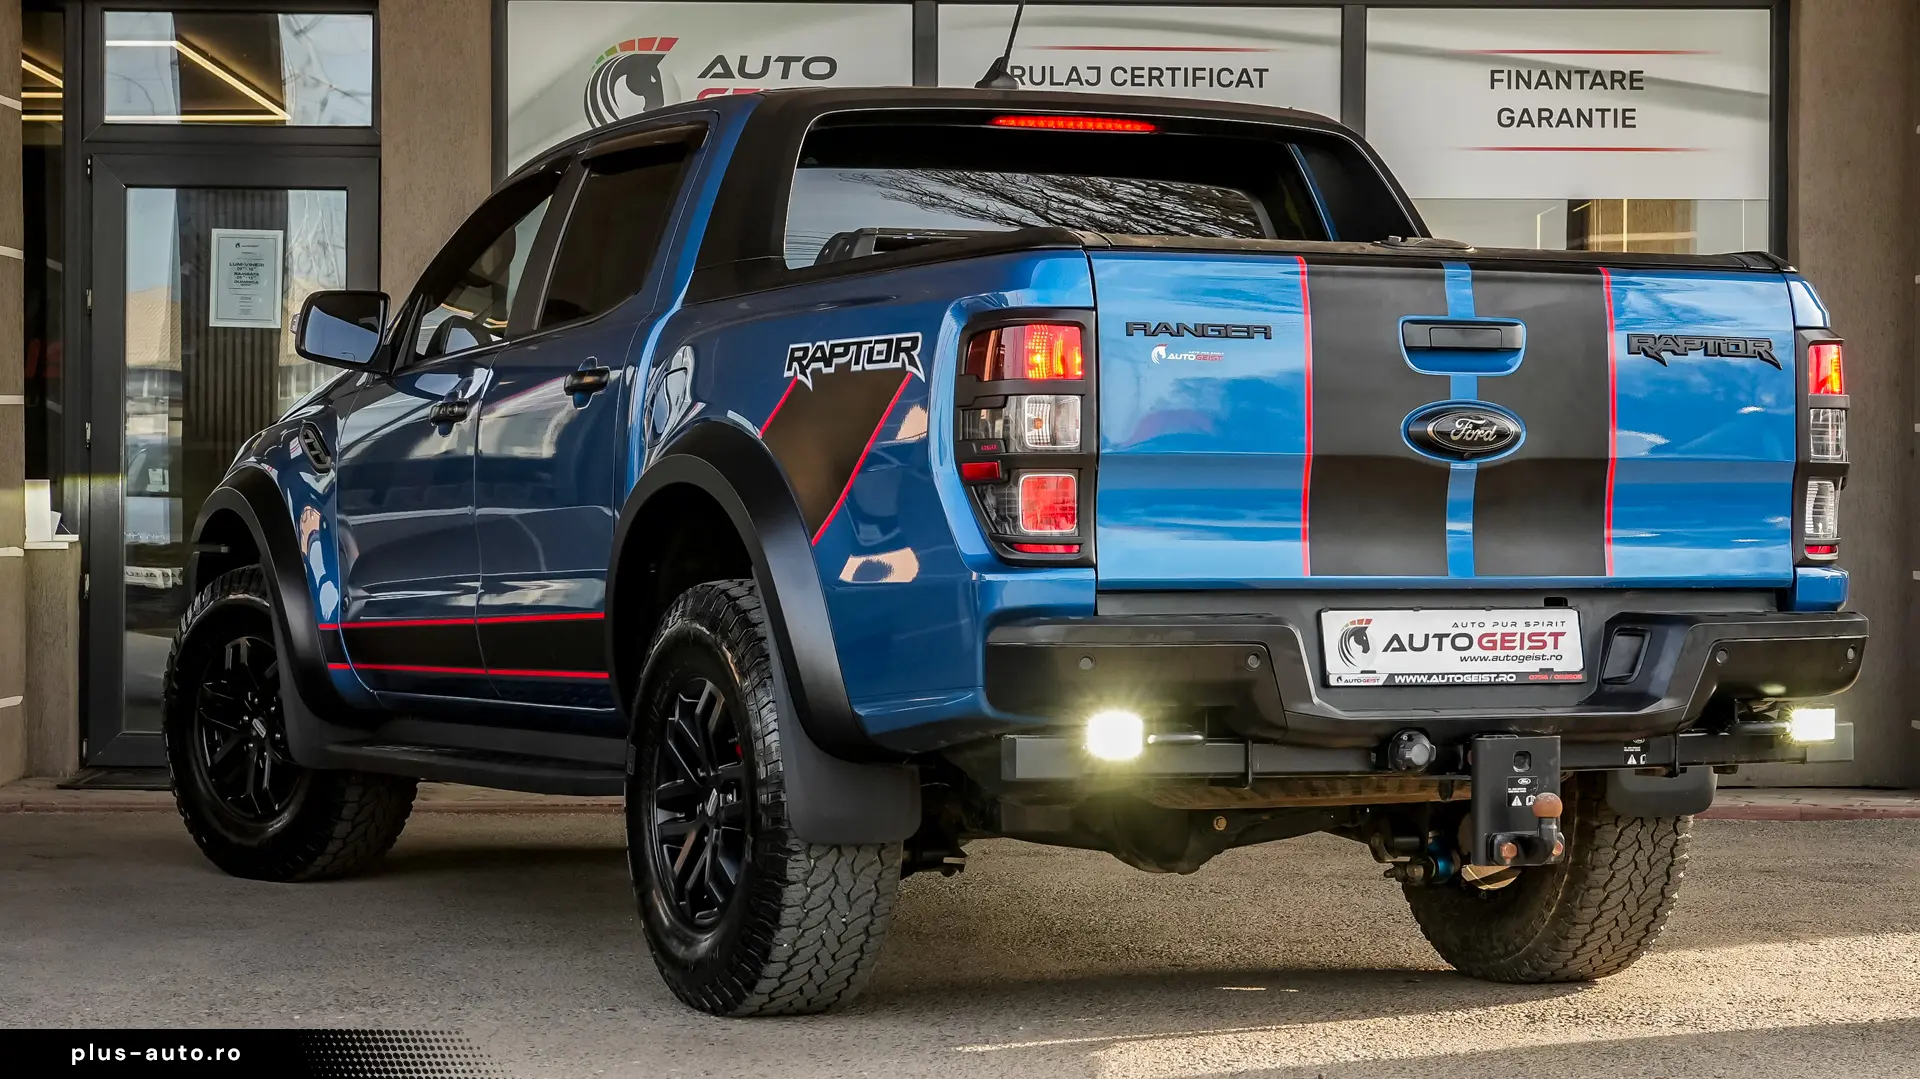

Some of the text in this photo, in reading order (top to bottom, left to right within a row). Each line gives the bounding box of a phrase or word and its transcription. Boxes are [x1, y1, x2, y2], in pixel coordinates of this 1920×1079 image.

[697, 54, 837, 80] AUTO
[1110, 66, 1269, 88] CERTIFICAT
[1490, 69, 1645, 91] FINANTARE
[1497, 107, 1637, 129] GARANTIE
[1126, 322, 1272, 339] RANGER
[784, 332, 926, 392] RAPTOR
[1627, 333, 1783, 370] RAPTOR
[1450, 418, 1498, 441] Ford
[1524, 620, 1566, 628] SPIRIT
[1381, 631, 1567, 652] AUTOGEIST
[1459, 652, 1563, 664] www.autogeist.ro
[1394, 673, 1517, 684] WWW.AUTOGEIST.RO
